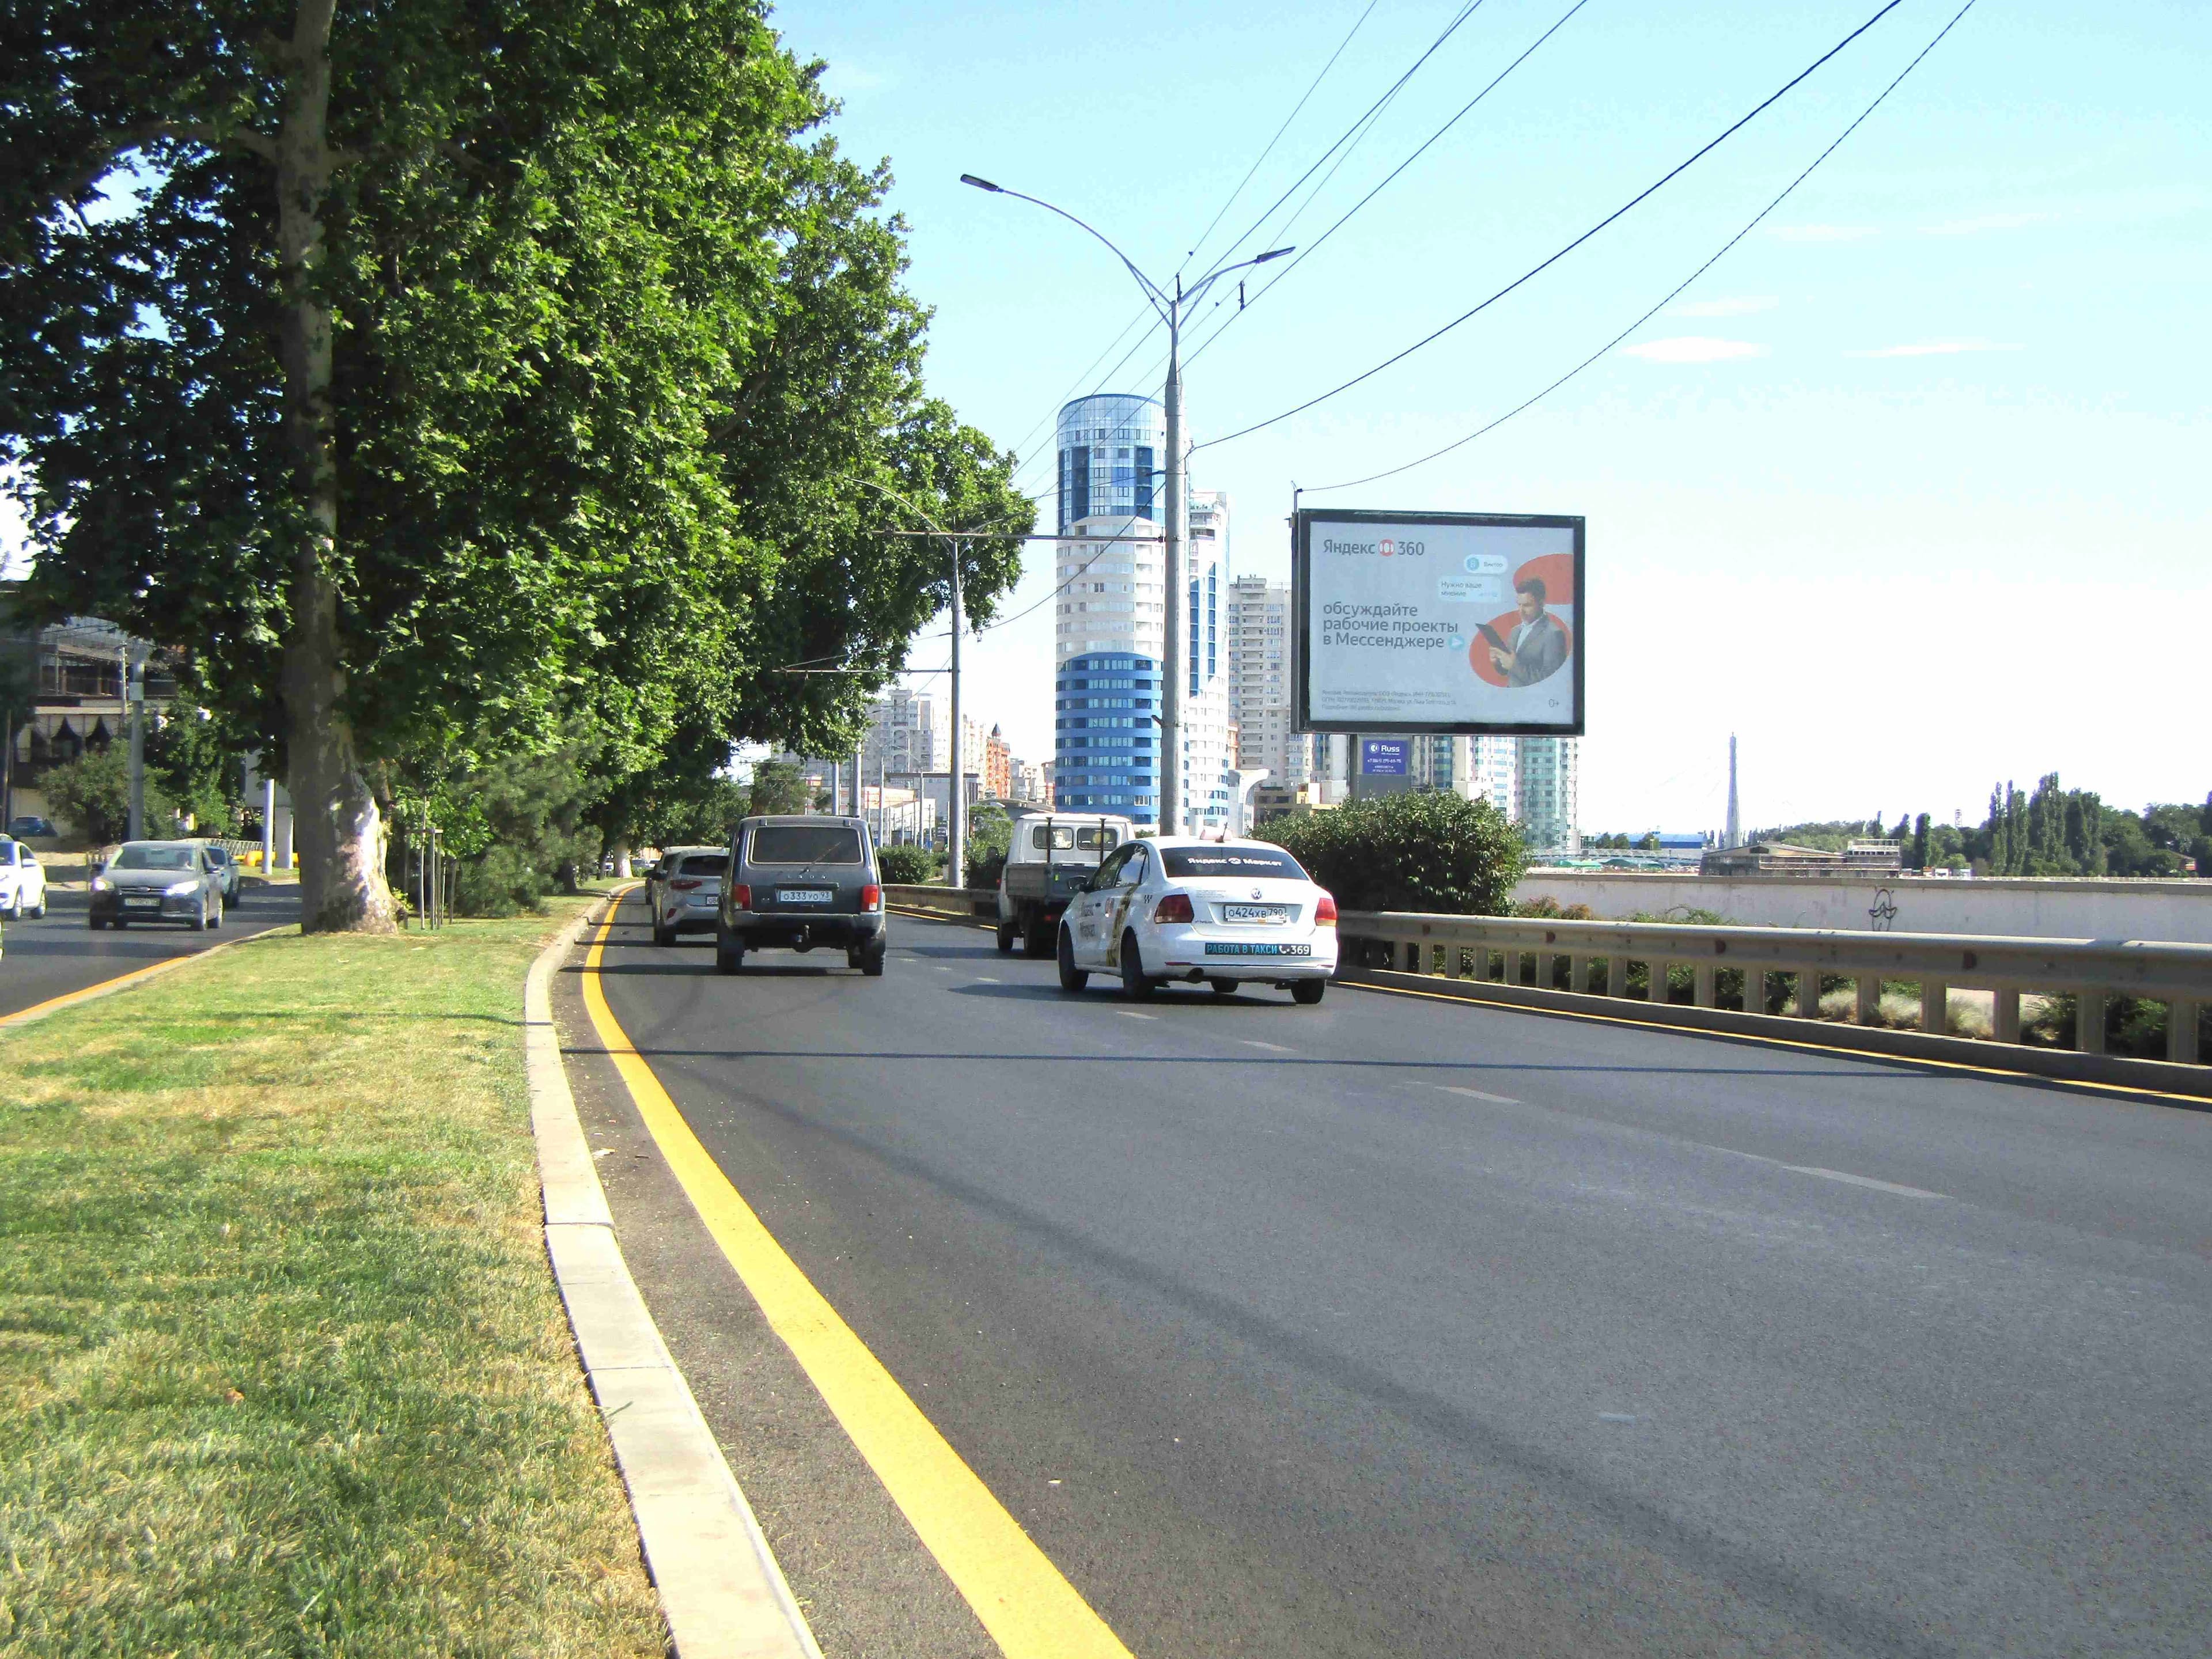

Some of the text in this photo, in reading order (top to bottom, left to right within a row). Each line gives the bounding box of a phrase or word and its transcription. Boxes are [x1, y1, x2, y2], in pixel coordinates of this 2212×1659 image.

[1323, 539, 1425, 556] Яндекс 360
[1323, 601, 1418, 618] обсуждайте
[1323, 617, 1459, 634] рабочие проекты
[1323, 632, 1445, 650] в Мессенджере
[1243, 858, 1282, 866] Маркет
[1207, 944, 1239, 954] РАБОТА
[1242, 945, 1248, 954] В
[1251, 945, 1277, 955] ТАКСИ
